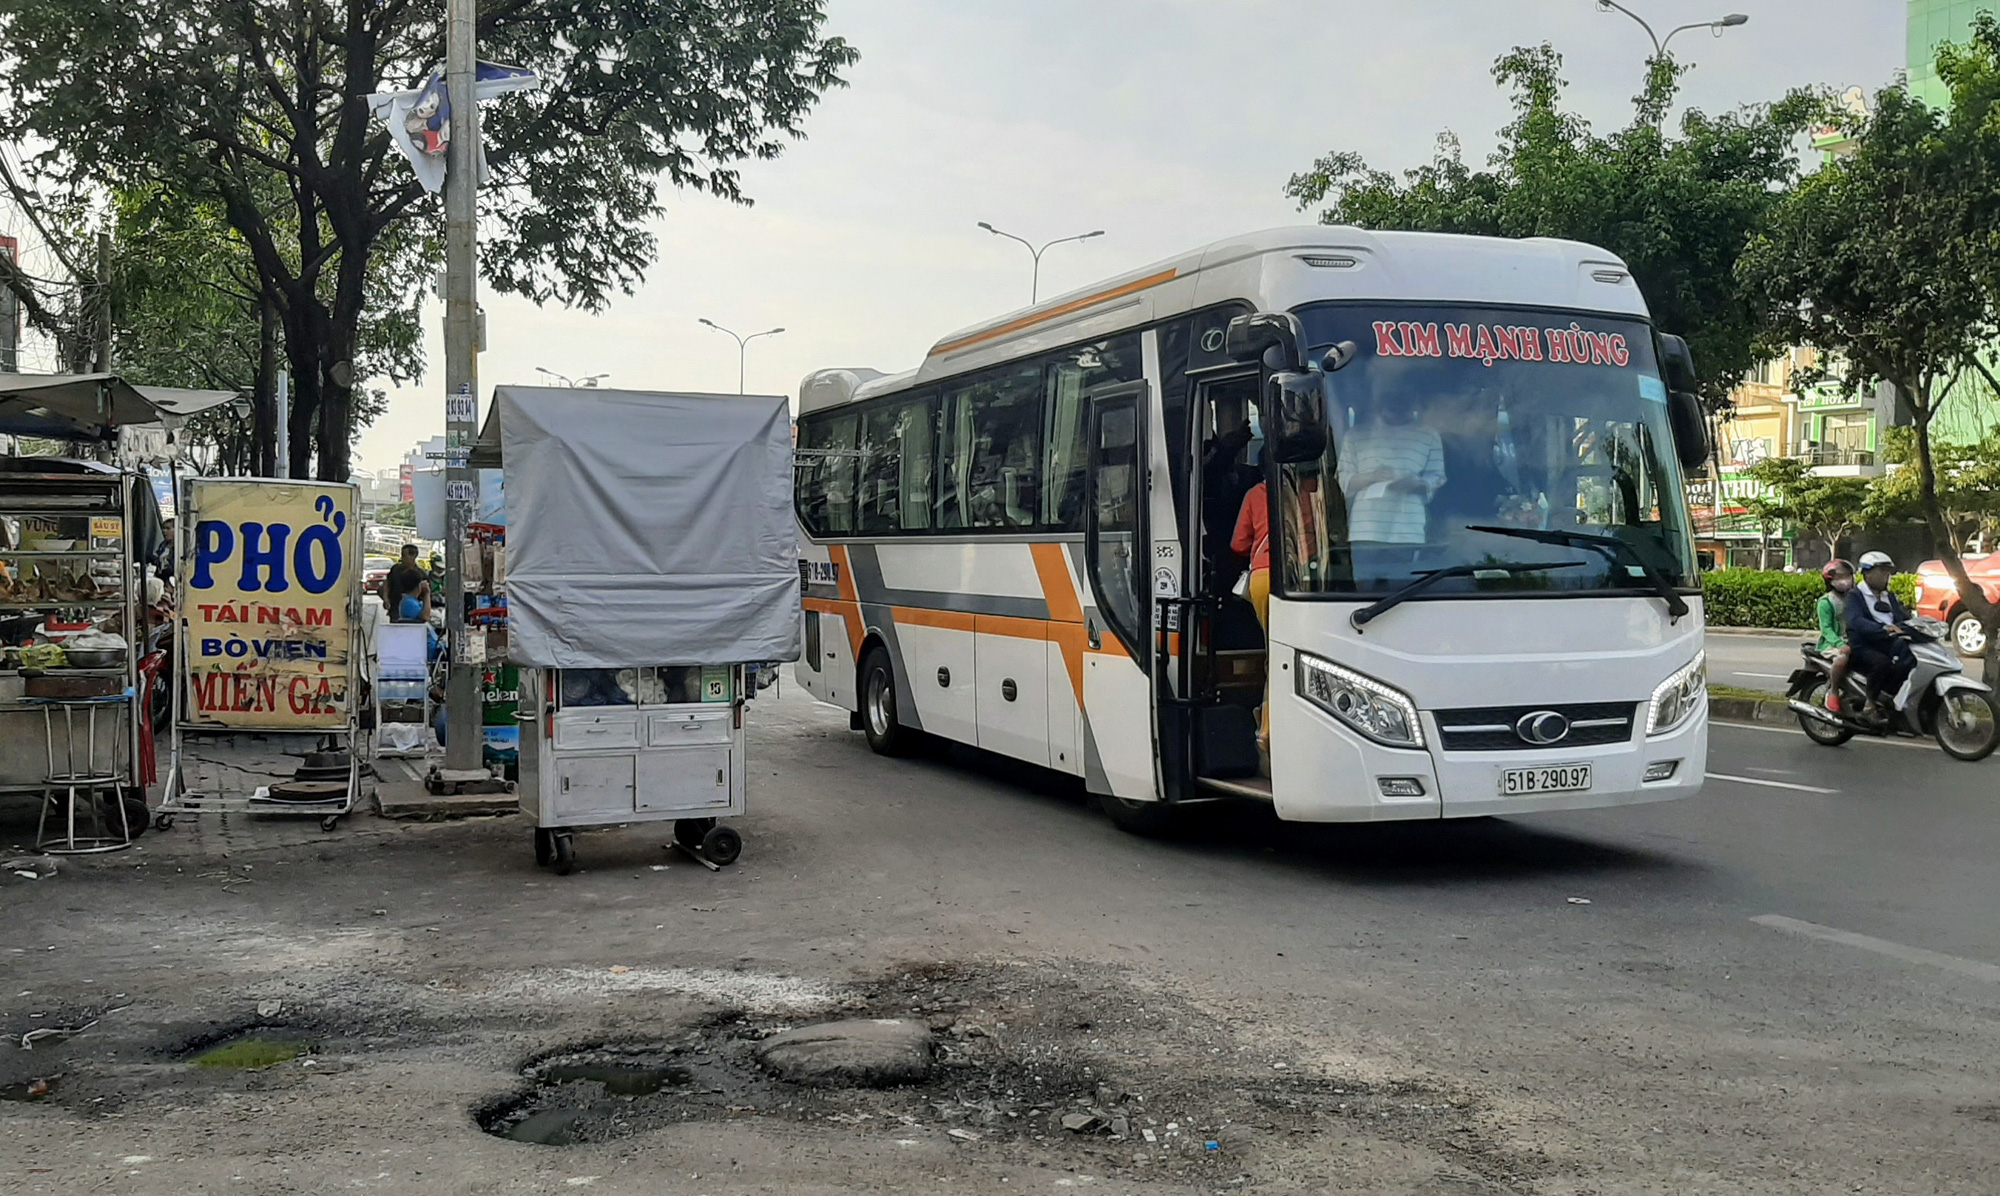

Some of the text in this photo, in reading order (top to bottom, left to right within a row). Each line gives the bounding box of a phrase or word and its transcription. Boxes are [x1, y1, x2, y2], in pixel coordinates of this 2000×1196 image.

[1372, 321, 1629, 367] KIM MẠNH HÙNG
[189, 494, 347, 595] PHỞ
[197, 599, 249, 623] TÁI
[201, 632, 249, 658] BÒ
[191, 658, 278, 712] MIẾN
[1507, 767, 1588, 791] 51B-290.97
